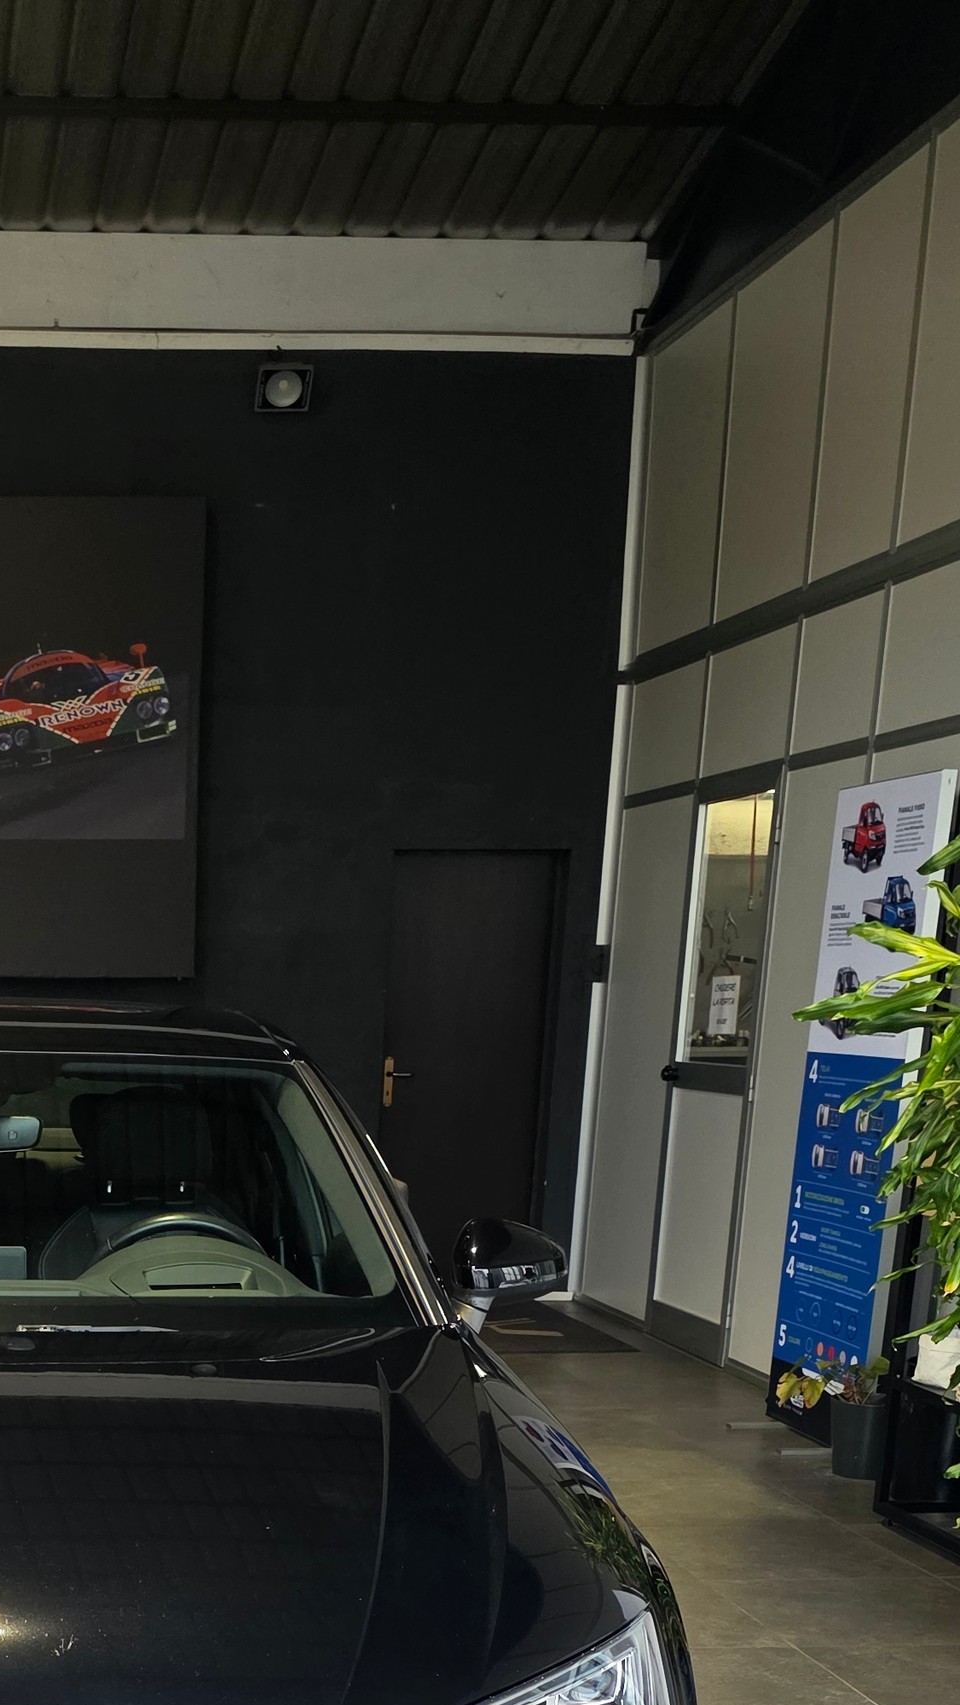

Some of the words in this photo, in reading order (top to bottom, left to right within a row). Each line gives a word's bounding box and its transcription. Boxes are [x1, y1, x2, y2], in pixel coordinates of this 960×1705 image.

[39, 698, 127, 726] RENOWN
[809, 1059, 819, 1083] 4
[794, 1185, 802, 1209] 1
[790, 1219, 798, 1243] 2
[786, 1255, 795, 1278] 4
[778, 1323, 787, 1347] 5
